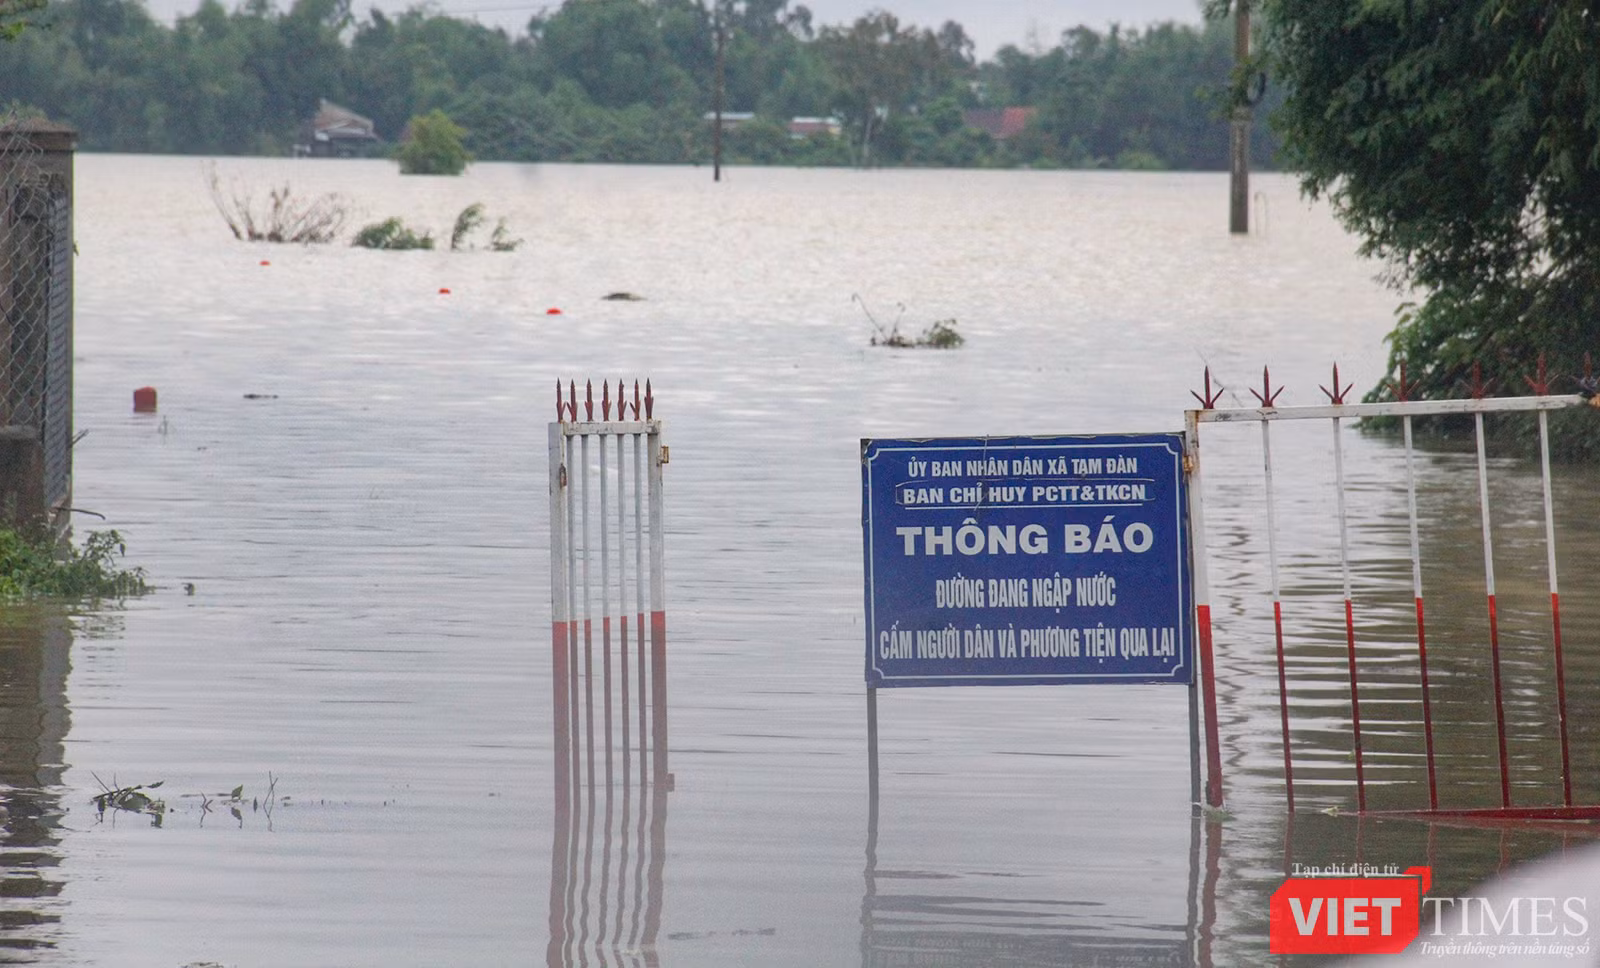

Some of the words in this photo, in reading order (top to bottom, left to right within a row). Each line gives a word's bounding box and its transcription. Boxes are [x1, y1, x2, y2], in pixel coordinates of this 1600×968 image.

[908, 456, 927, 477] ỦY
[932, 461, 962, 476] BAN
[967, 456, 1008, 475] NHÂN
[1012, 456, 1043, 475] DÂN
[1047, 456, 1067, 474] XÃ
[1106, 455, 1137, 473] ĐÀN
[904, 489, 943, 503] BAN
[950, 482, 983, 503] CHỈ
[989, 486, 1028, 502] HUY
[1032, 485, 1145, 501] PCTT&TKCN
[896, 518, 1049, 556] THÔNG
[1064, 516, 1153, 553] BÁO
[936, 572, 984, 609] ĐƯỜNG
[989, 579, 1028, 607] ĐANG
[1032, 572, 1072, 613] NGẬP
[1076, 572, 1116, 607] NƯỚC
[880, 620, 912, 659] CẤM
[917, 624, 960, 659] NGƯỜI
[965, 625, 992, 658] DÂN
[997, 623, 1017, 658] VÀ
[1021, 626, 1079, 657] PHƯƠNG
[1083, 622, 1115, 663] TIỆN
[1120, 628, 1148, 660] QUA
[1152, 628, 1175, 662] LẠI
